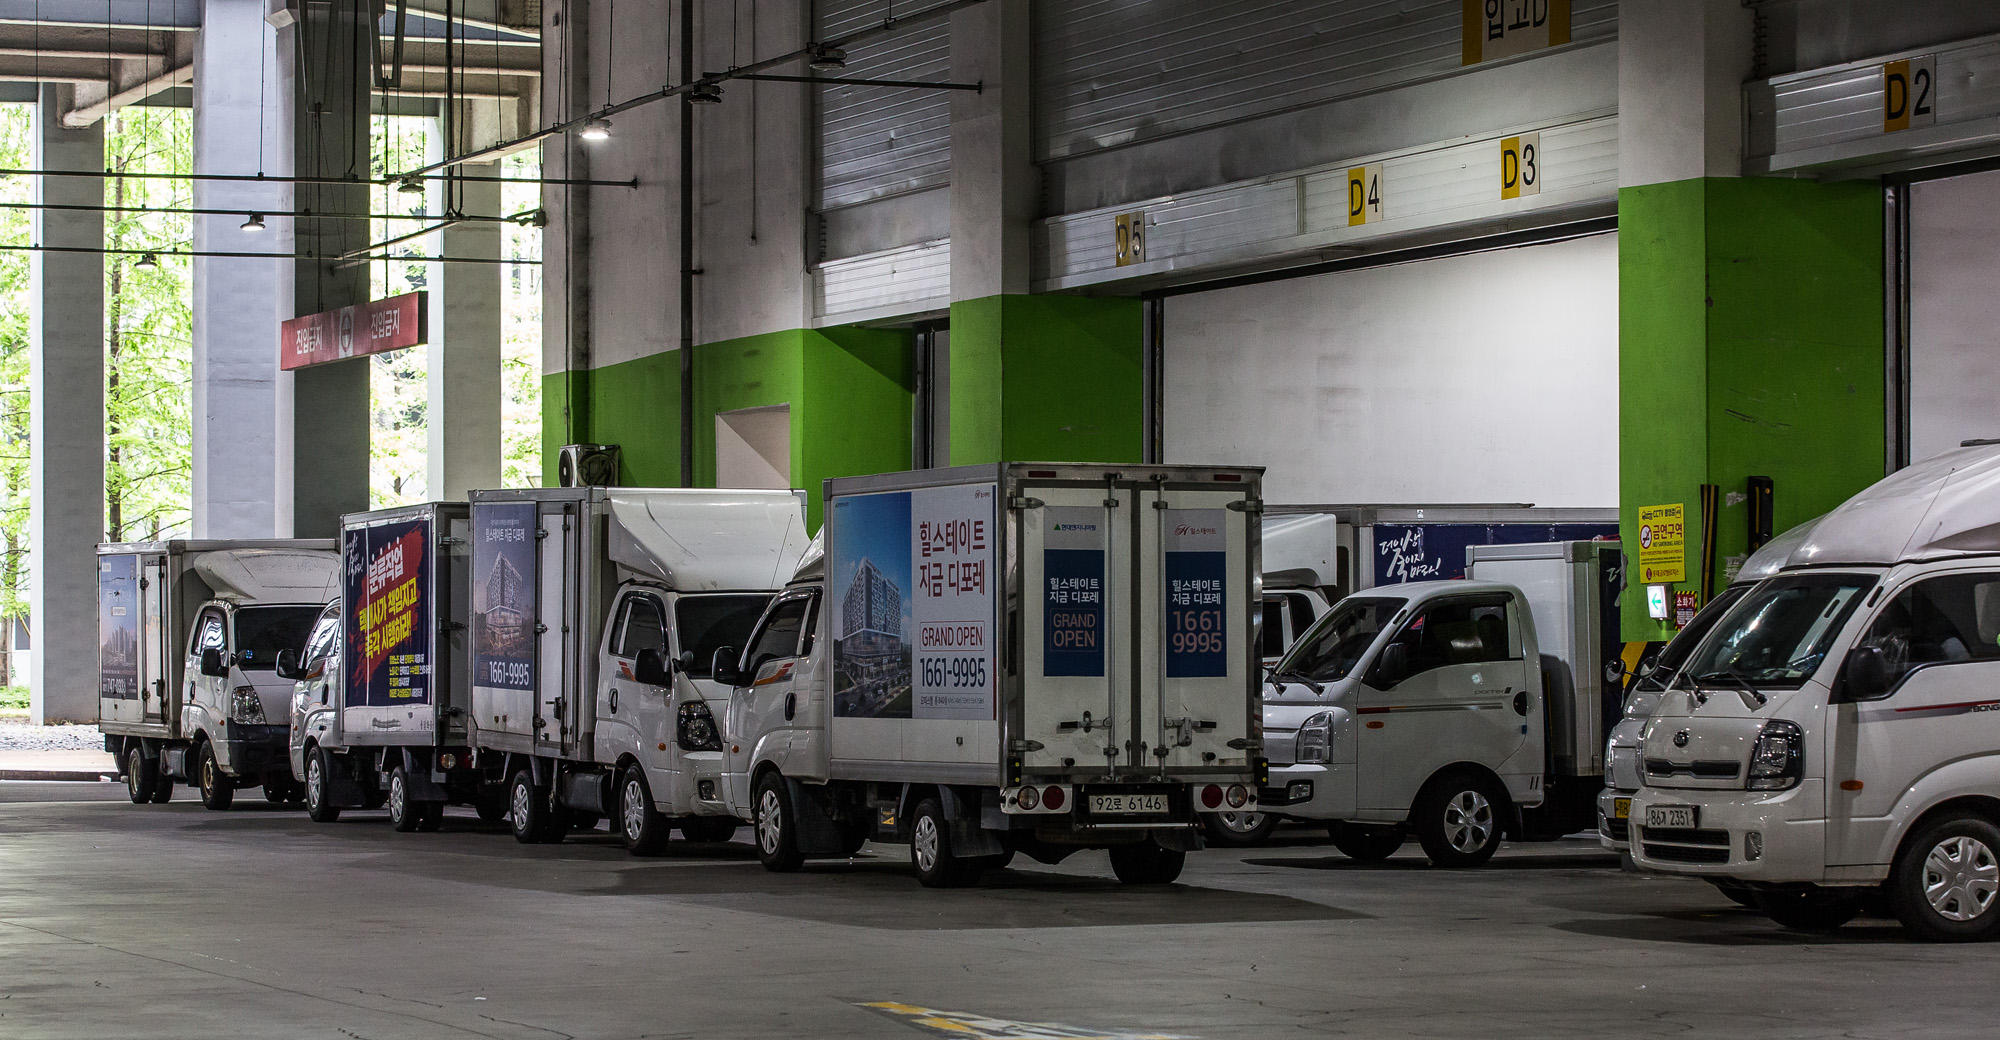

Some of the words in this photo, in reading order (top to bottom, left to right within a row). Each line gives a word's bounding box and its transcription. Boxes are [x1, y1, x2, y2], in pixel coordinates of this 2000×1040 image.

[371, 307, 400, 340] 진입금지
[295, 324, 323, 355] 진입금지
[920, 518, 986, 558] 힐스테이트
[1190, 527, 1217, 535] 힐스테이트
[1653, 523, 1683, 540] 금연구역
[369, 543, 404, 595] 분류작업
[920, 562, 944, 597] 지금
[948, 559, 985, 597] 디포레
[1050, 577, 1099, 590] 힐스테이트
[1172, 579, 1221, 592] 힐스테이트
[387, 576, 418, 616] 책임지고
[1050, 591, 1068, 604] 지금
[1071, 591, 1099, 604] 디포레
[1172, 592, 1191, 605] 지금
[1193, 592, 1221, 605] 디포레
[1677, 596, 1694, 607] 소화기
[1053, 613, 1096, 628] GRAND
[1173, 610, 1221, 631] 1661
[921, 626, 954, 647] GRAND
[956, 626, 983, 646] OPEN
[1053, 630, 1095, 647] OPEN
[1172, 632, 1222, 653] 9995
[489, 660, 530, 686] 1661-9995
[920, 657, 986, 688] 1661-9995
[1096, 797, 1122, 811] 92로
[1129, 797, 1161, 811] 6146
[1669, 810, 1690, 826] 2351
